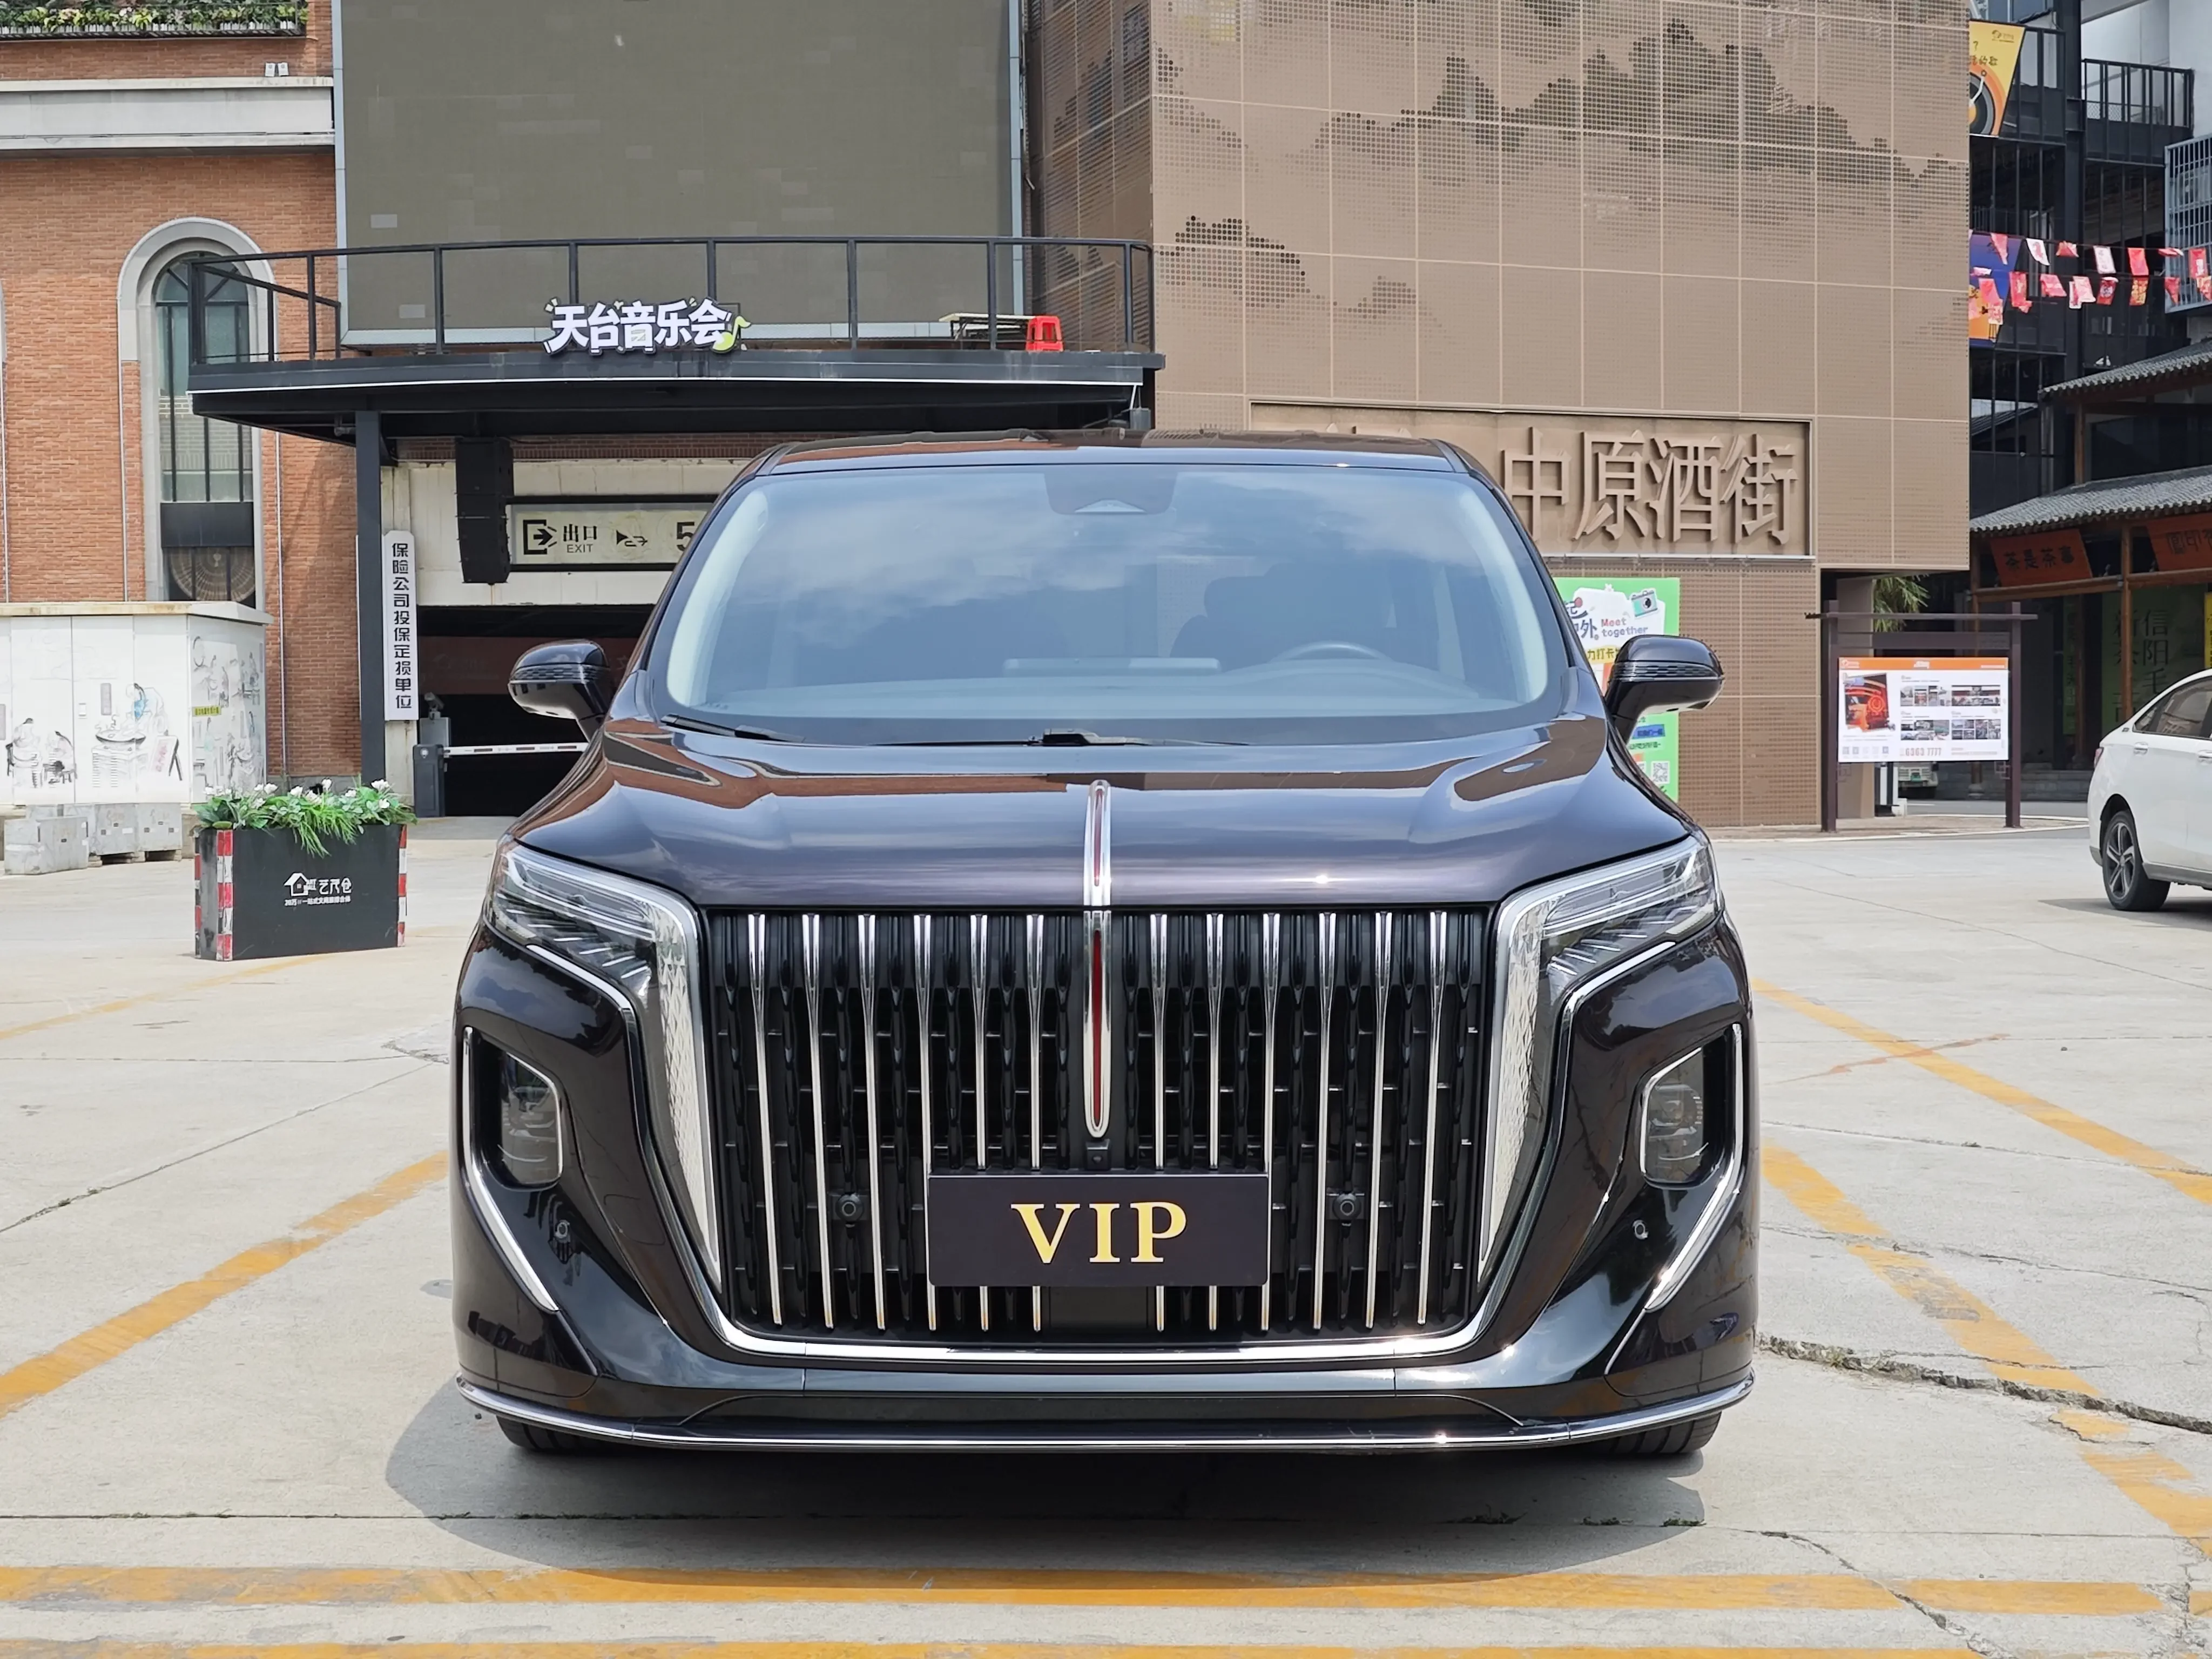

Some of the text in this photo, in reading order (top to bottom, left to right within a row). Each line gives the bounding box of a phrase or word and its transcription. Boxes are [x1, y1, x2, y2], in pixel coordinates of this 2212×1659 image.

[543, 297, 732, 354] 天台音乐会
[1501, 427, 1798, 544] 中原酒街
[563, 524, 597, 542] 出口
[567, 544, 593, 553] EXIT
[392, 542, 412, 709] 保险公司投保定损单位
[1574, 618, 1599, 640] 外。
[1601, 626, 1648, 637] together
[1587, 648, 1620, 661] 力打卡
[1010, 1202, 1187, 1264] VIP
